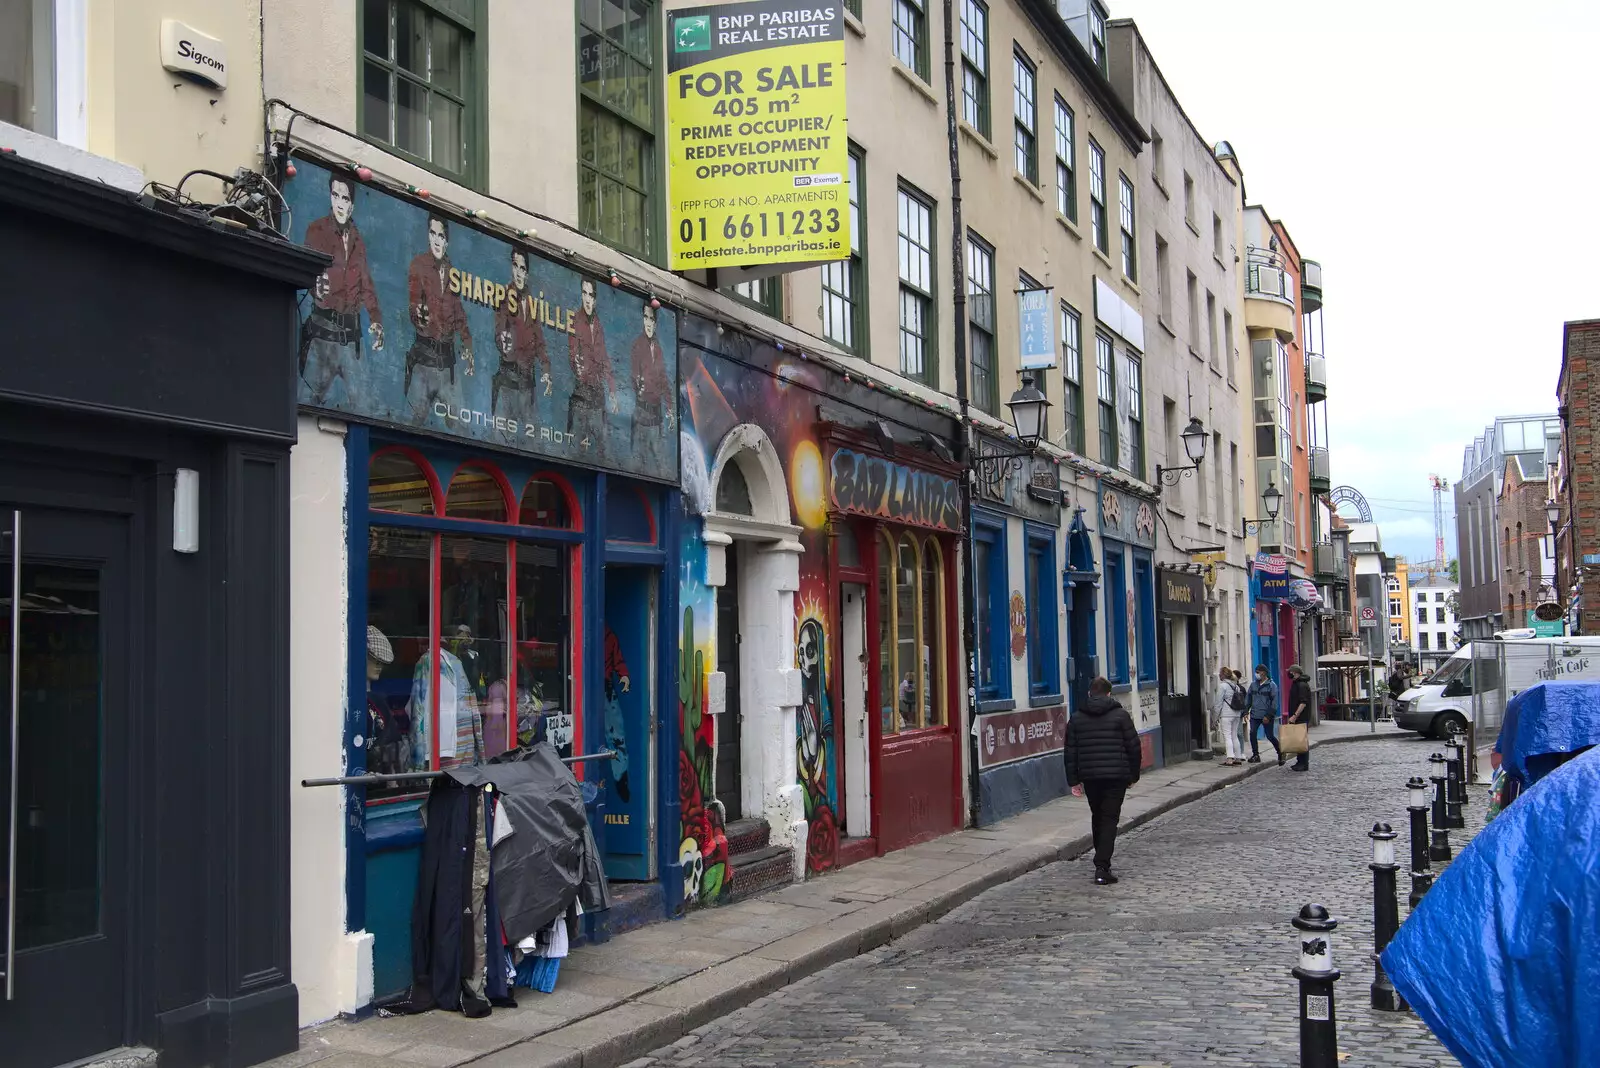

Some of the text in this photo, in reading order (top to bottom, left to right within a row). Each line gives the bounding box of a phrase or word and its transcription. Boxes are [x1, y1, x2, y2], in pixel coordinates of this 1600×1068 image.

[718, 8, 835, 29] BNP PARIBAS
[719, 24, 831, 44] REAL ESTATE
[177, 40, 224, 72] Sigcom
[679, 62, 832, 99] FOR SALE
[712, 97, 759, 118] 405
[681, 114, 833, 141] PRIME OCCUPIER/
[685, 136, 831, 160] REDEVELOPMENT
[696, 157, 820, 179] OPPORTUNITY
[796, 176, 839, 186] BER Exempt
[680, 189, 838, 212] (FPP FOR 4 NO. APARTMENTS)
[679, 208, 840, 243] 01 6611233
[680, 238, 841, 260] realestate.bnpparibas.ie
[449, 267, 519, 316] SHARP'S
[1024, 313, 1034, 352] THAI
[434, 402, 518, 434] CLOTHES
[525, 424, 535, 438] 2
[580, 437, 592, 450] 4
[1566, 657, 1589, 673] Café
